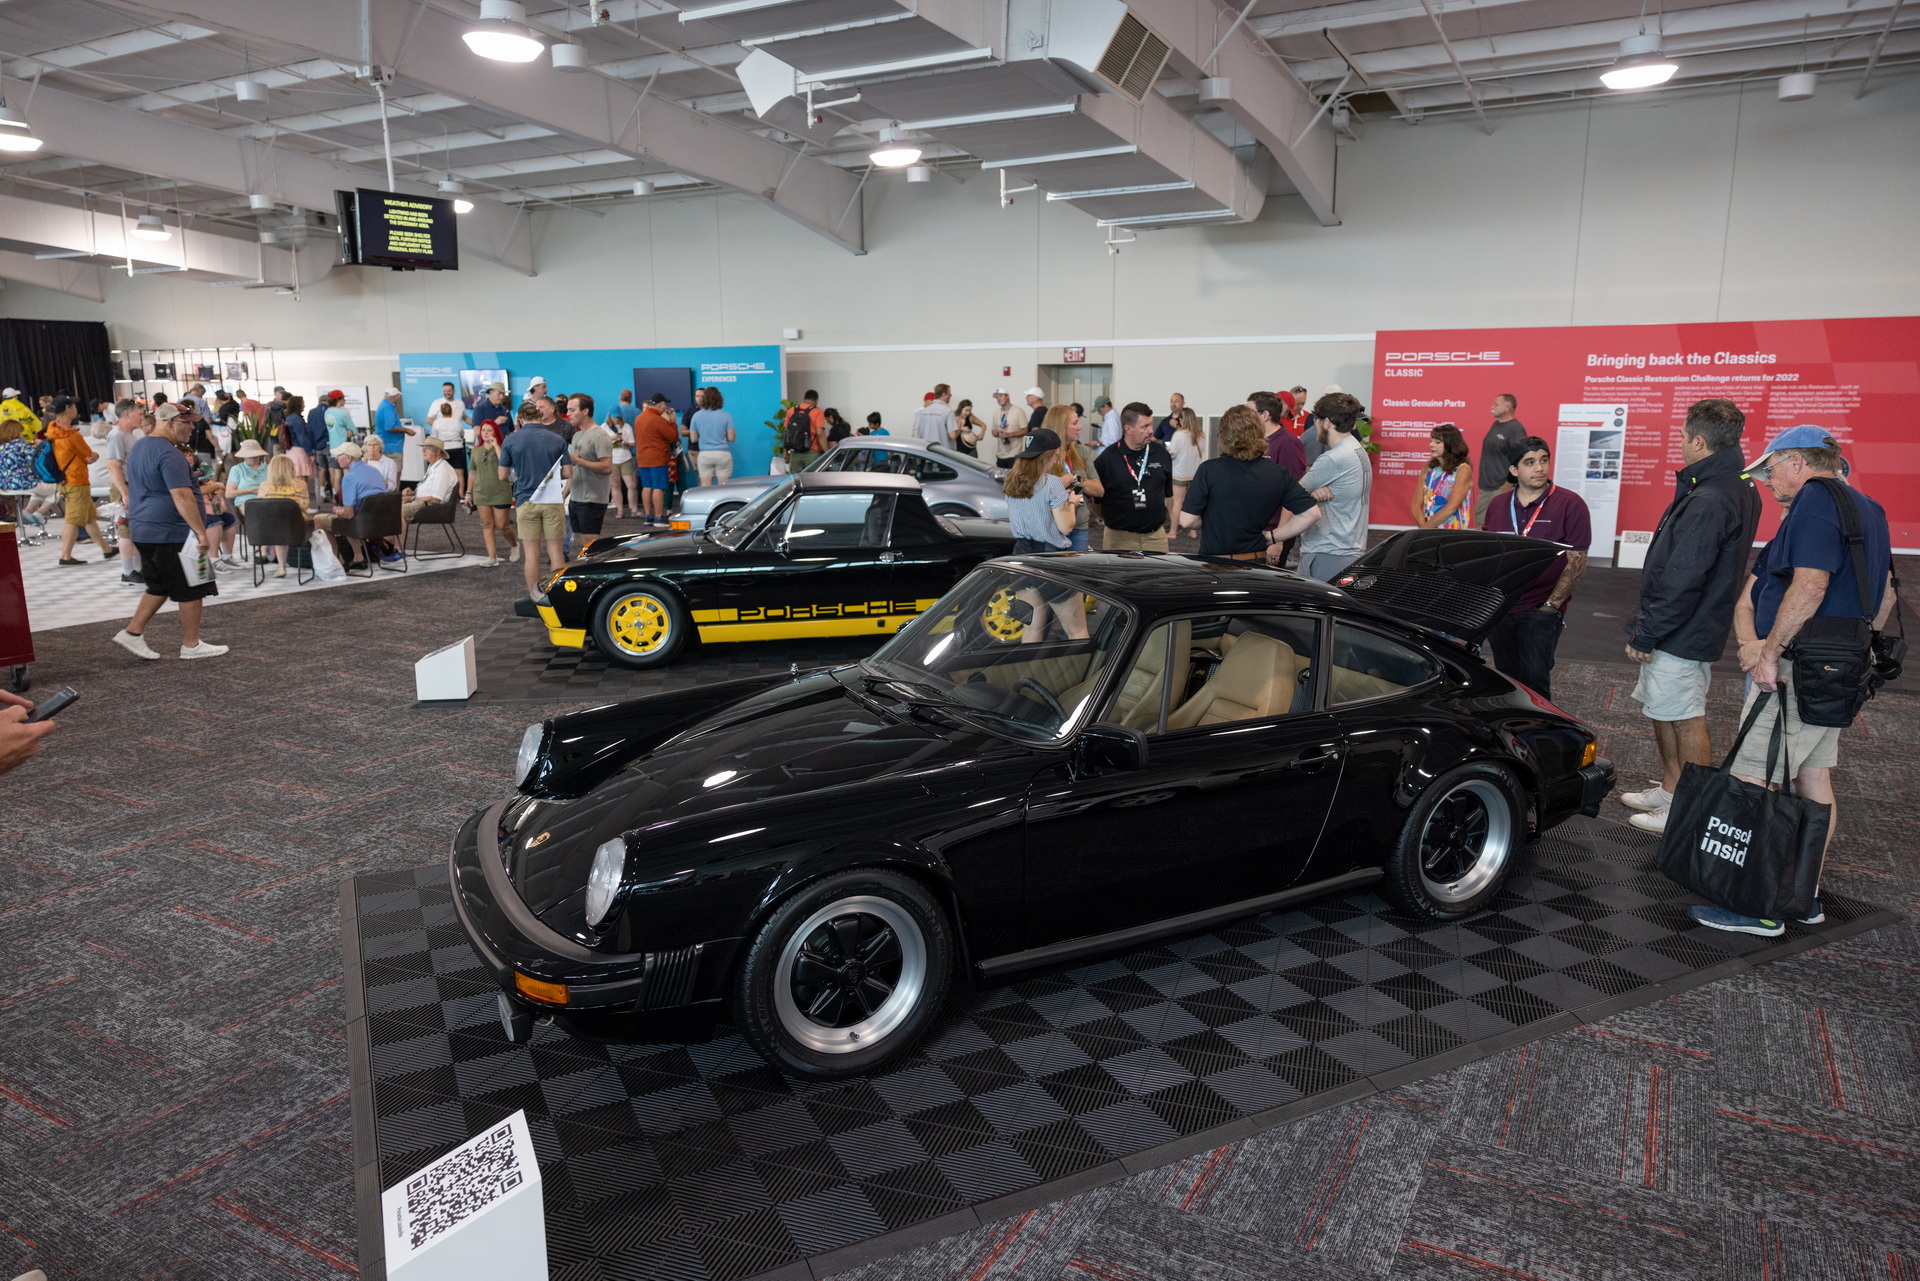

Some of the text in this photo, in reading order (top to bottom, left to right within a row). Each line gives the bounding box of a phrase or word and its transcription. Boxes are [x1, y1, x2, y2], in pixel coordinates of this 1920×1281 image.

[1386, 352, 1500, 361] PORSCHE
[1587, 351, 1776, 369] Bringing back the Classics
[1385, 369, 1423, 377] CLASSIC
[1691, 374, 1730, 383] Challenge
[1411, 399, 1443, 407] Genuine
[1444, 399, 1466, 407] Parts
[741, 601, 916, 620] PORSCHE
